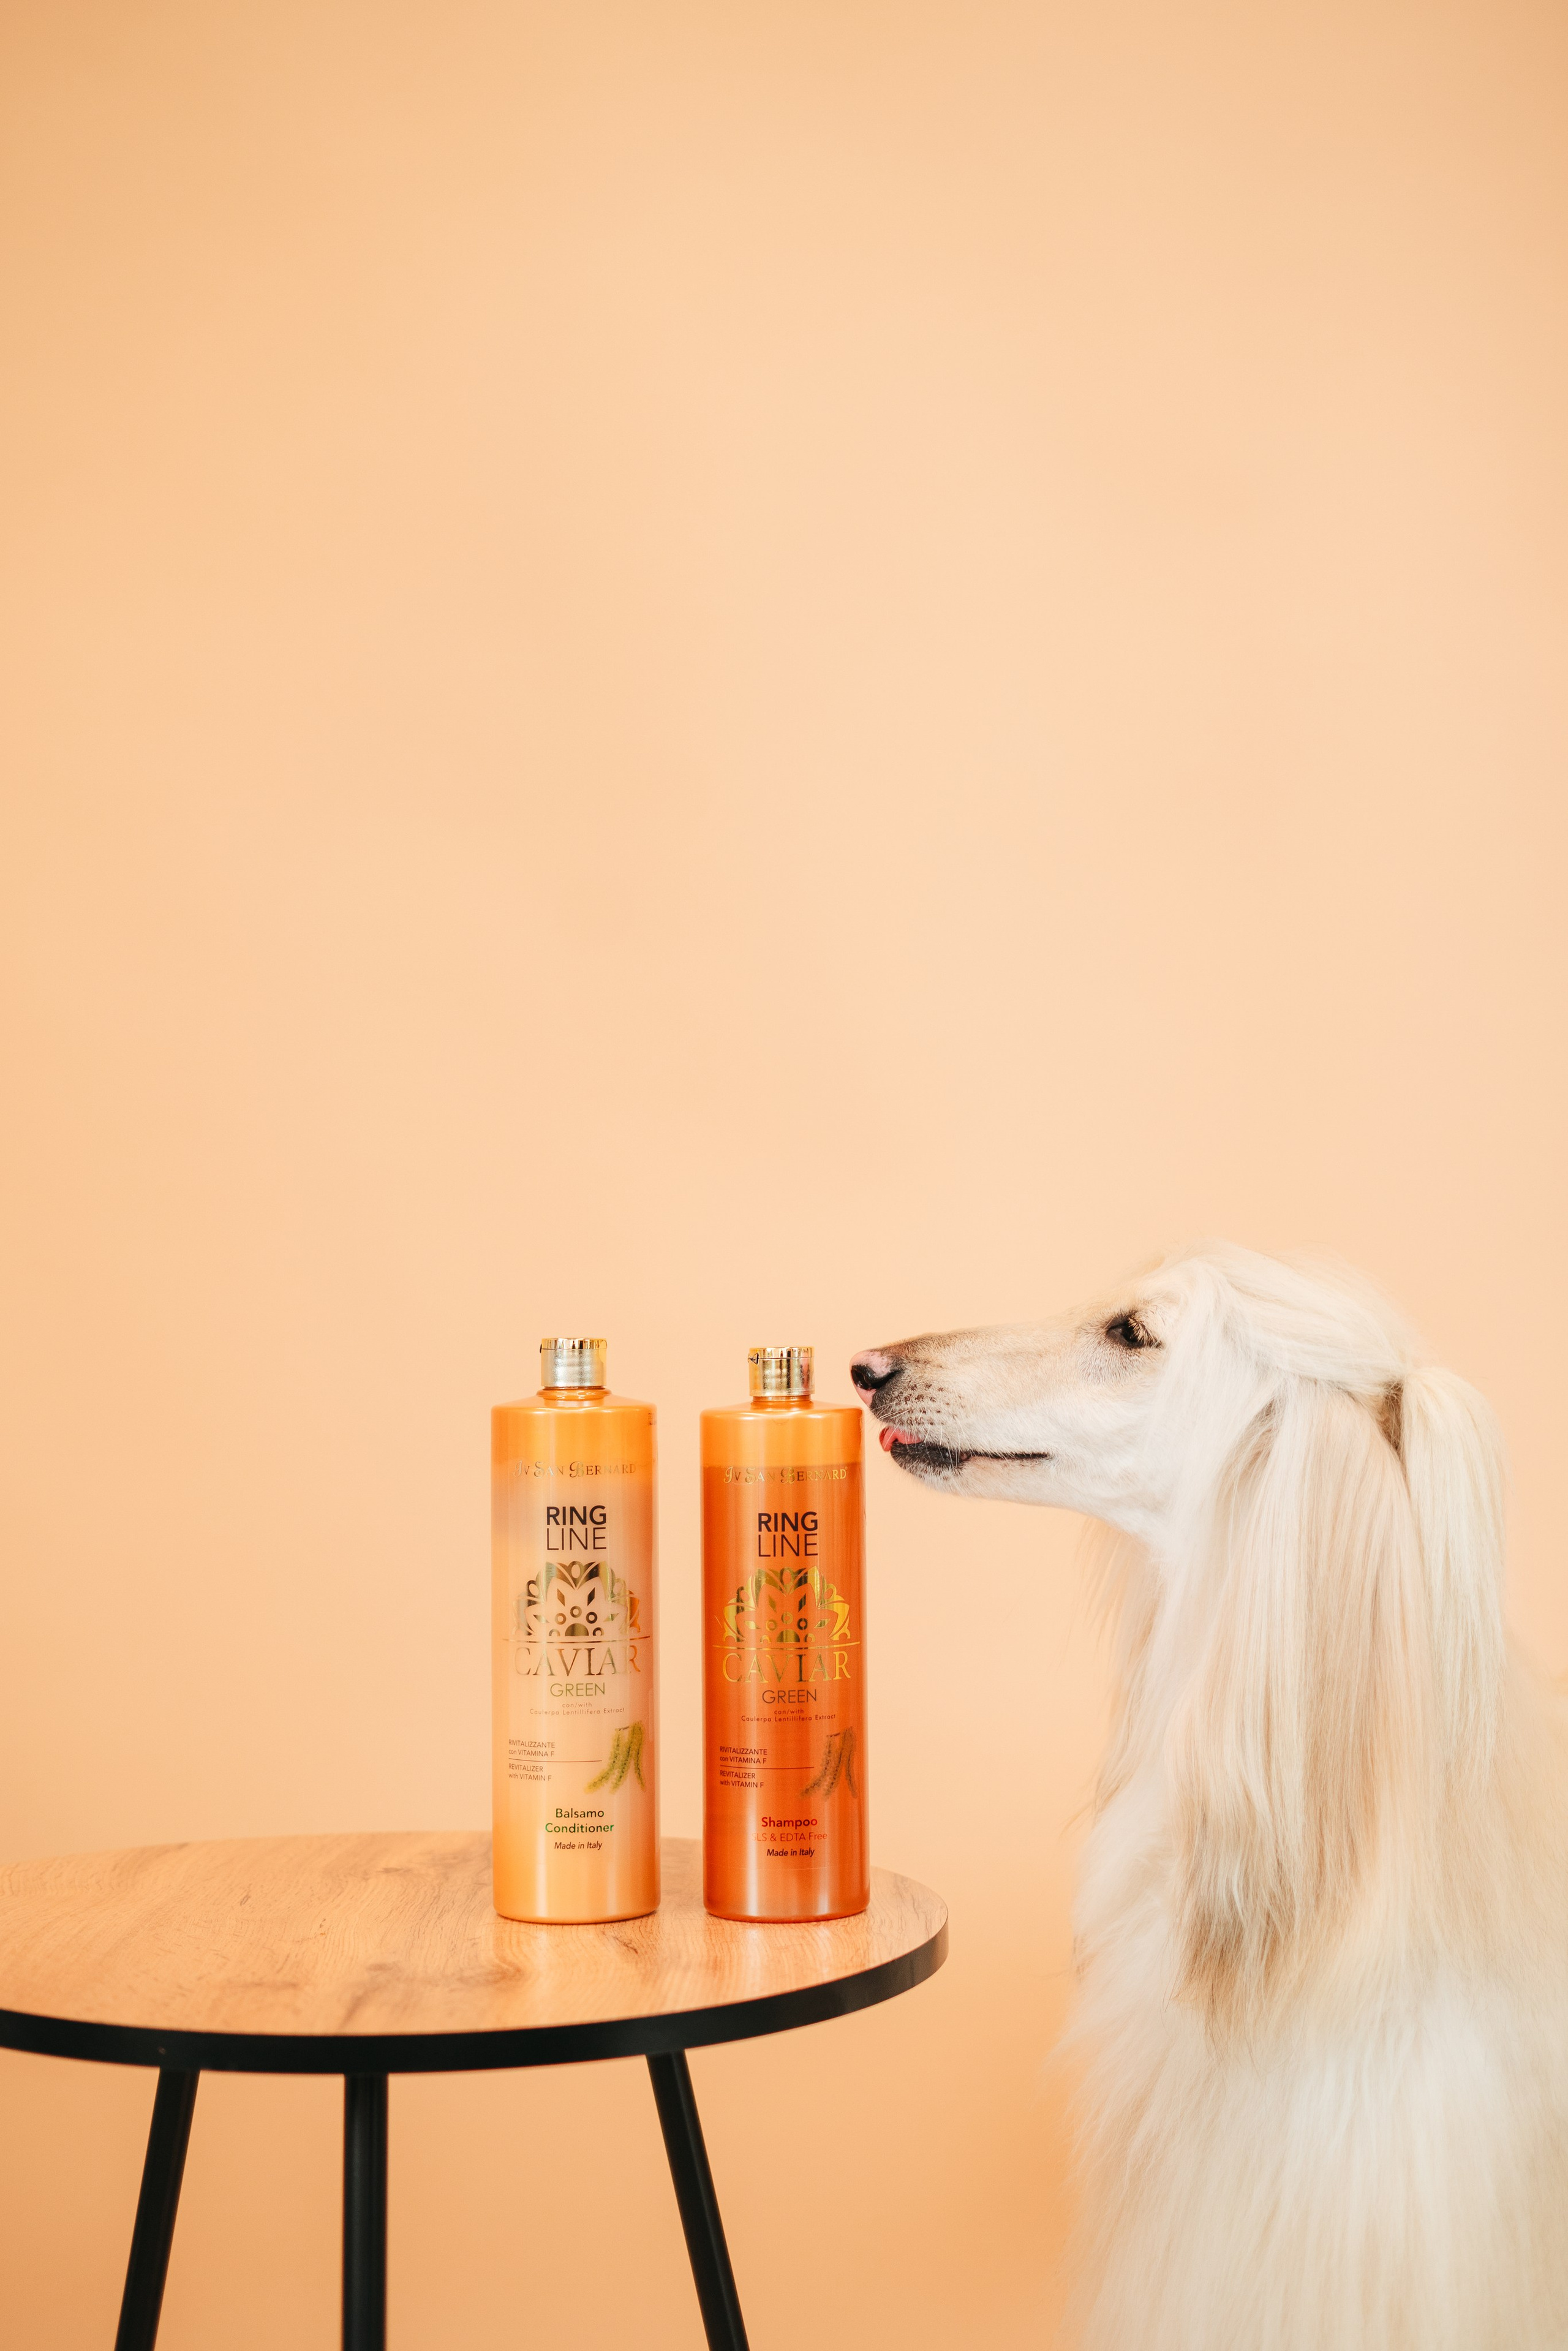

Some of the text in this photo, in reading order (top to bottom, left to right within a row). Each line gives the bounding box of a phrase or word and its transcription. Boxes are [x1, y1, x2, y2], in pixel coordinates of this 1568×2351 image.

[546, 1504, 607, 1526] RING
[758, 1511, 818, 1532] RING
[546, 1526, 607, 1550] LINE
[758, 1533, 818, 1557] LINE
[514, 1645, 641, 1677] CAVIAR
[722, 1651, 851, 1683] CAVIAR
[549, 1682, 605, 1697] GREEN
[762, 1689, 817, 1704] GREEN
[508, 1739, 556, 1748] RIVITALIZZANTE
[719, 1746, 767, 1756] RIVITALIZZANTE
[508, 1763, 543, 1772] REVITALIZER
[719, 1770, 756, 1779] REVITALIZER
[555, 1808, 605, 1818] Balsamo
[545, 1822, 614, 1833] Conditioner
[761, 1816, 818, 1830] Shampoo
[751, 1832, 827, 1842] SLS & EDTA Free
[587, 1840, 603, 1851] Italy
[799, 1847, 815, 1857] Italy
